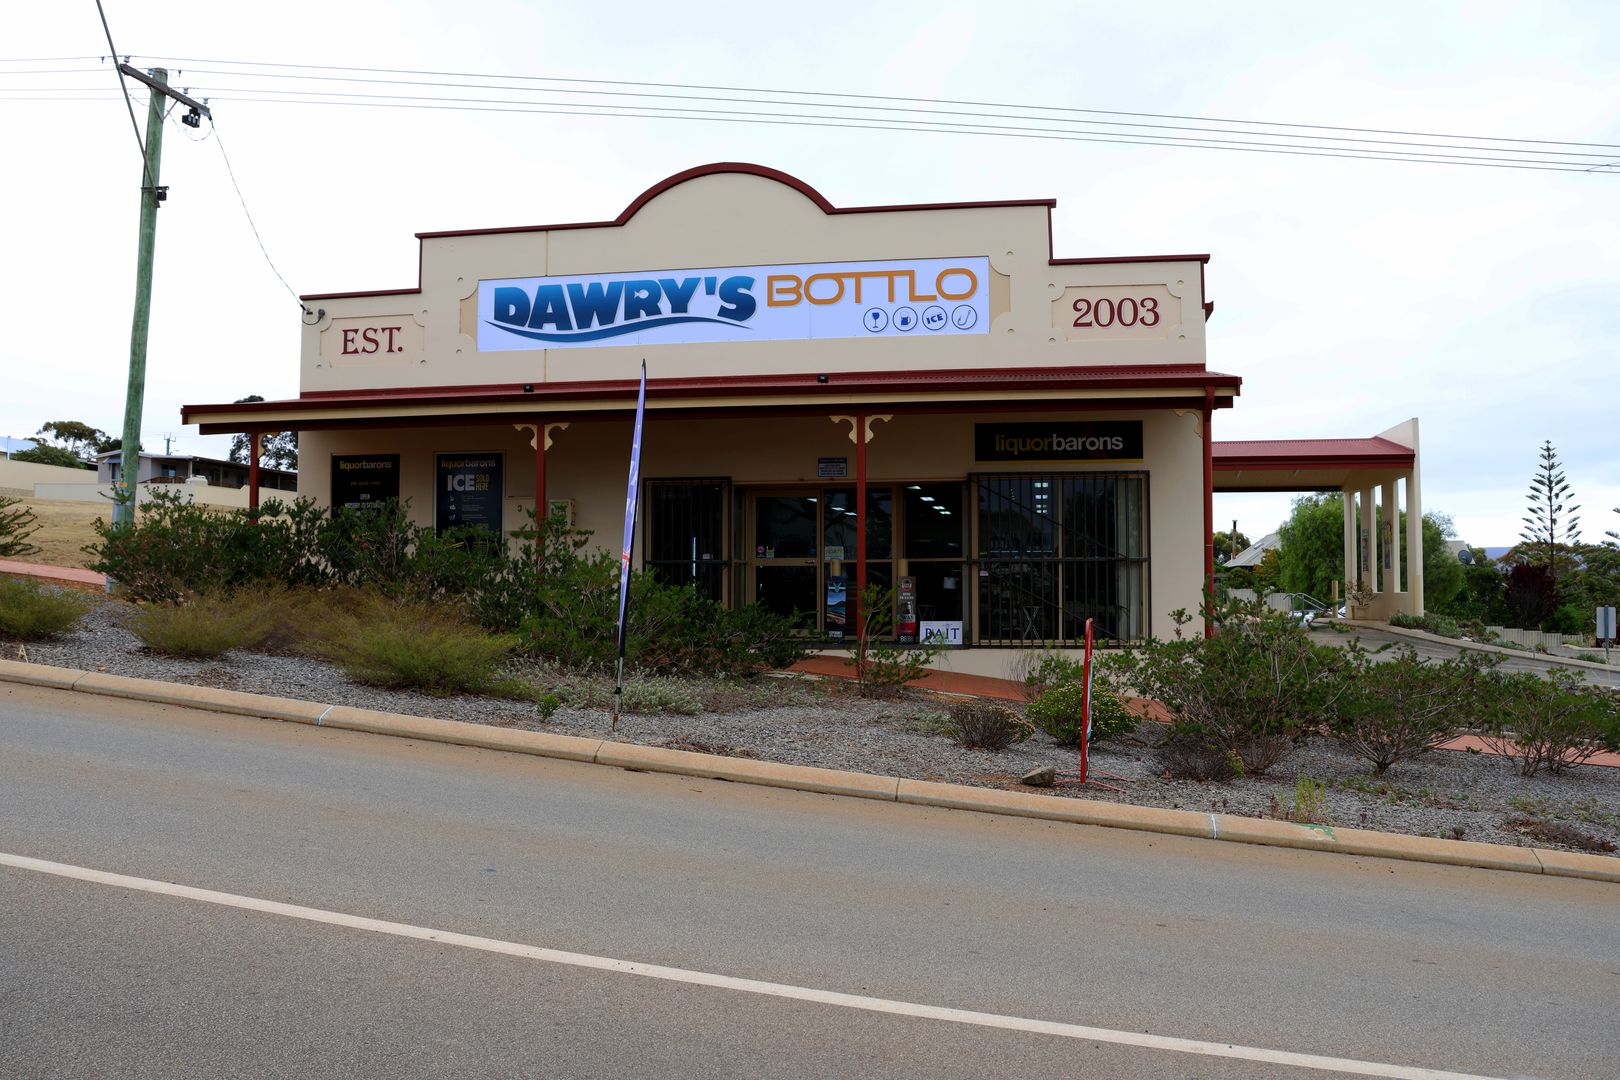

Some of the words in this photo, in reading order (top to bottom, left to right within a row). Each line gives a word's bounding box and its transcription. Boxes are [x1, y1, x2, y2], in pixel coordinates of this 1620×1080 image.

[494, 275, 757, 330] DAWRY'S
[768, 268, 978, 307] BOTTLO
[926, 313, 944, 325] ICE
[1072, 297, 1160, 328] 2003
[341, 326, 403, 355] EST.
[994, 433, 1124, 455] liquorbarons
[339, 461, 392, 471] liquorbarons
[441, 458, 496, 470] liquorbarons
[447, 474, 475, 492] ICE
[925, 628, 960, 639] BAIT
